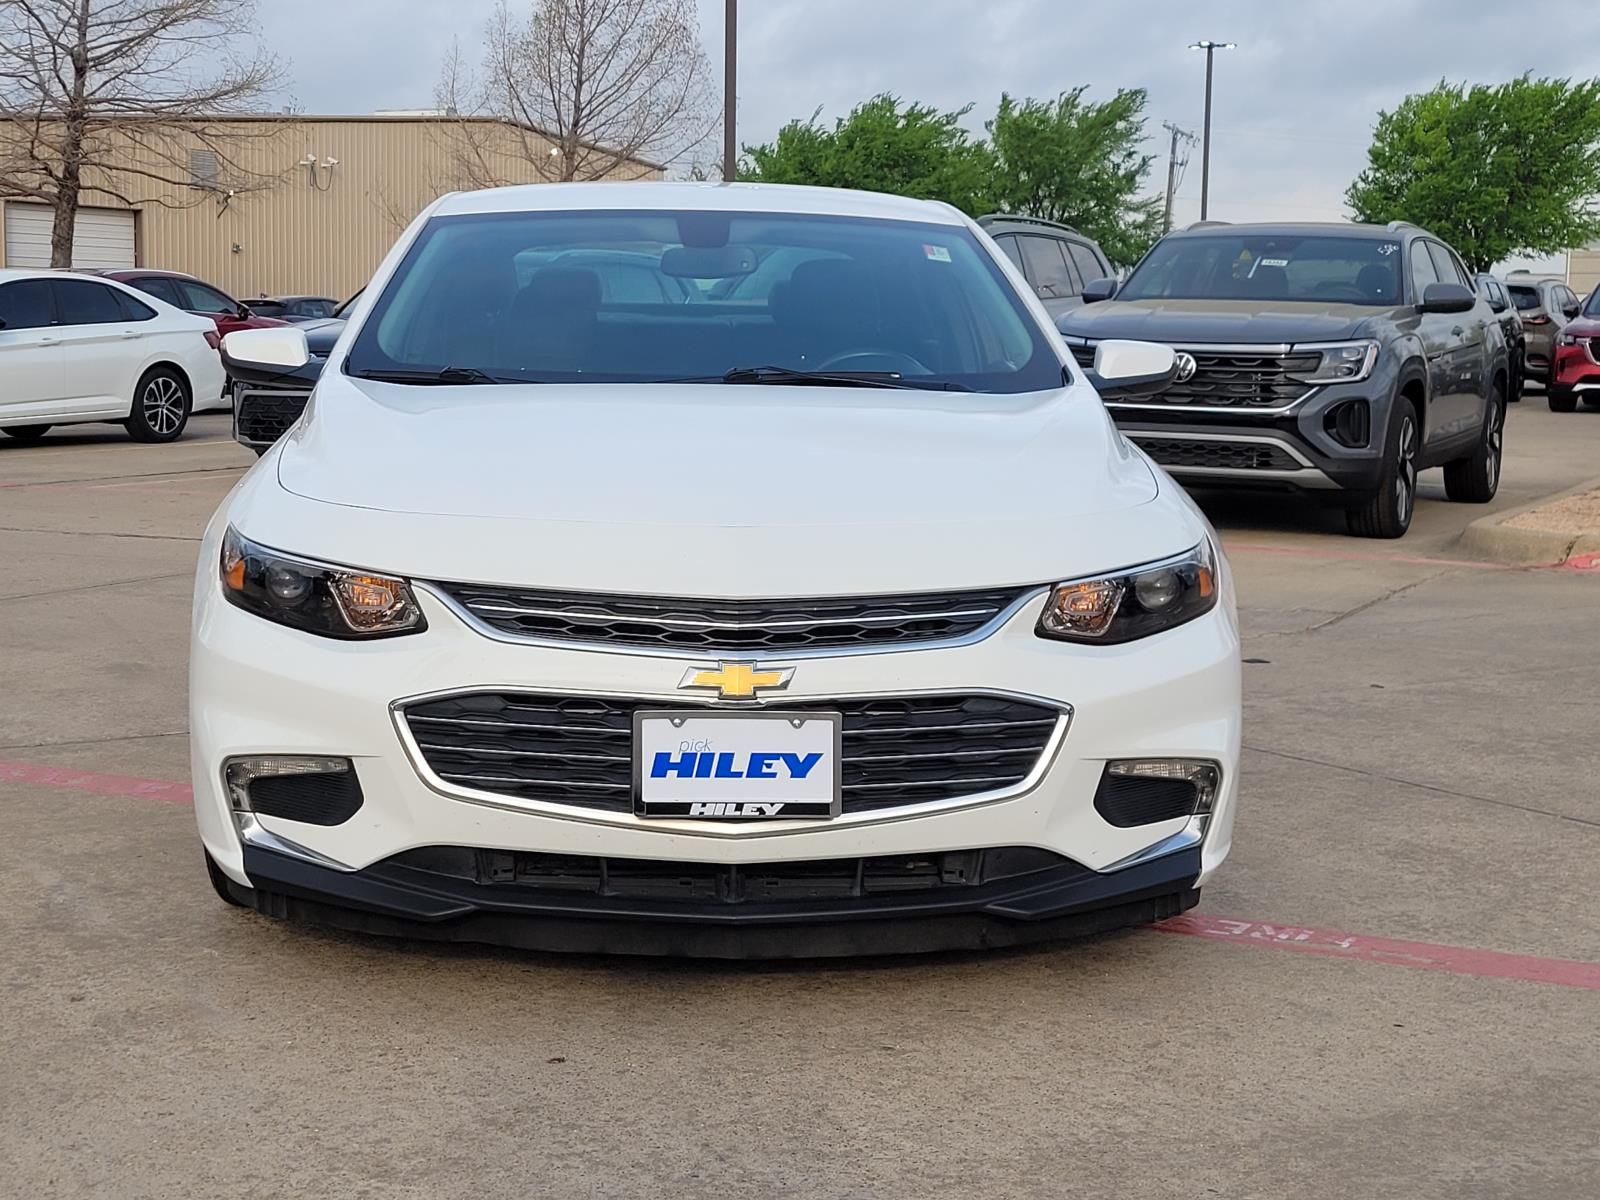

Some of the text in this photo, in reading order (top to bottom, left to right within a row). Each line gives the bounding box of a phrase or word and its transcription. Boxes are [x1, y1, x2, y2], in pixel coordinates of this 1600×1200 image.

[679, 738, 712, 755] pick
[650, 752, 824, 778] HILEY
[689, 803, 785, 816] HILEY
